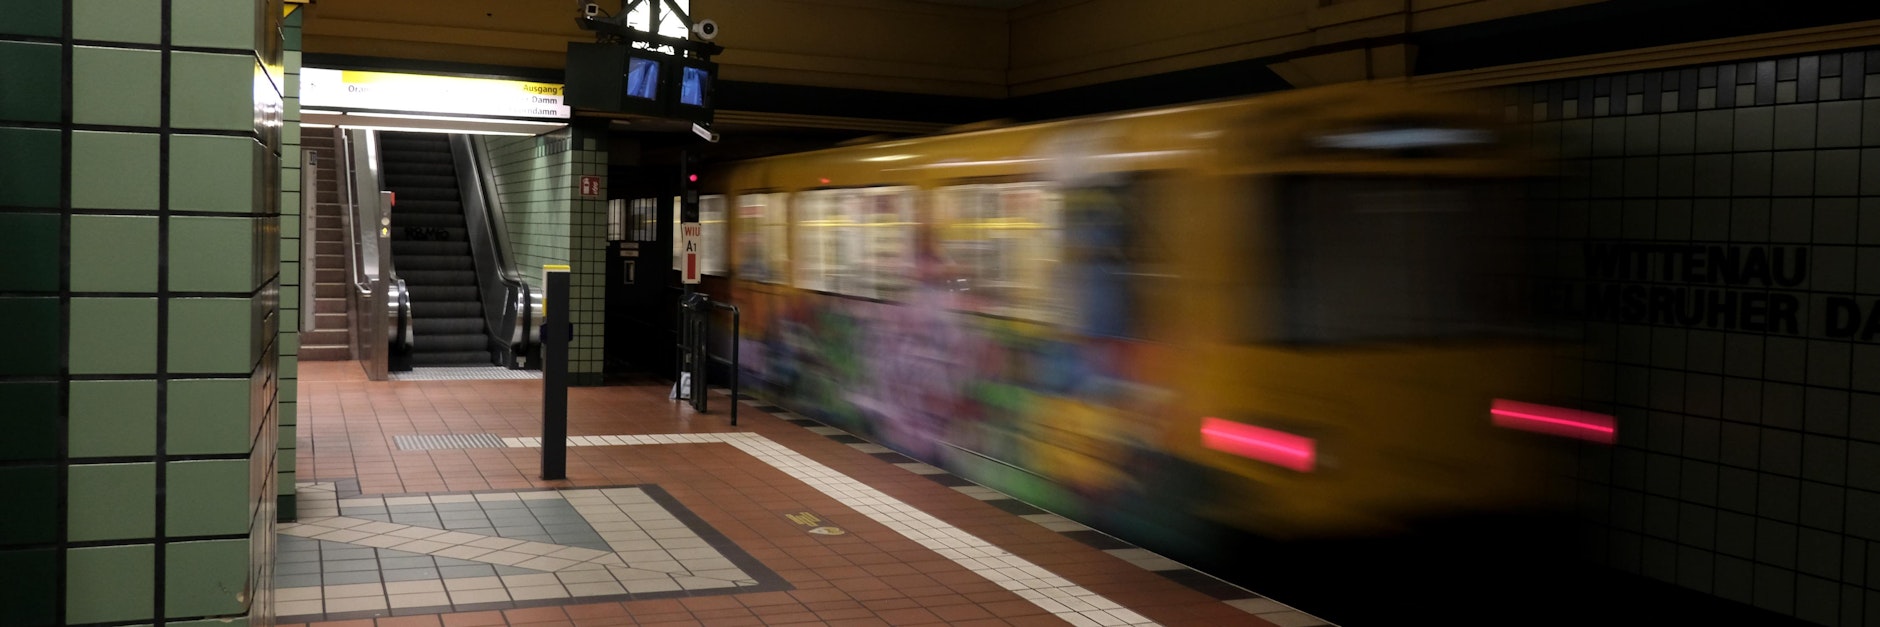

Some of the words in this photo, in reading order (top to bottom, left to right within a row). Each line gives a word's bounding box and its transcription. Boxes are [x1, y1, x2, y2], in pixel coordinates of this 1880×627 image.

[524, 84, 558, 95] Ausgang
[532, 95, 558, 104] Damm
[684, 226, 700, 236] WIU
[686, 240, 697, 252] A1
[1584, 242, 1807, 287] WITTENAU
[1533, 281, 1799, 335] ELMSRUHER
[1825, 296, 1880, 342] DA
